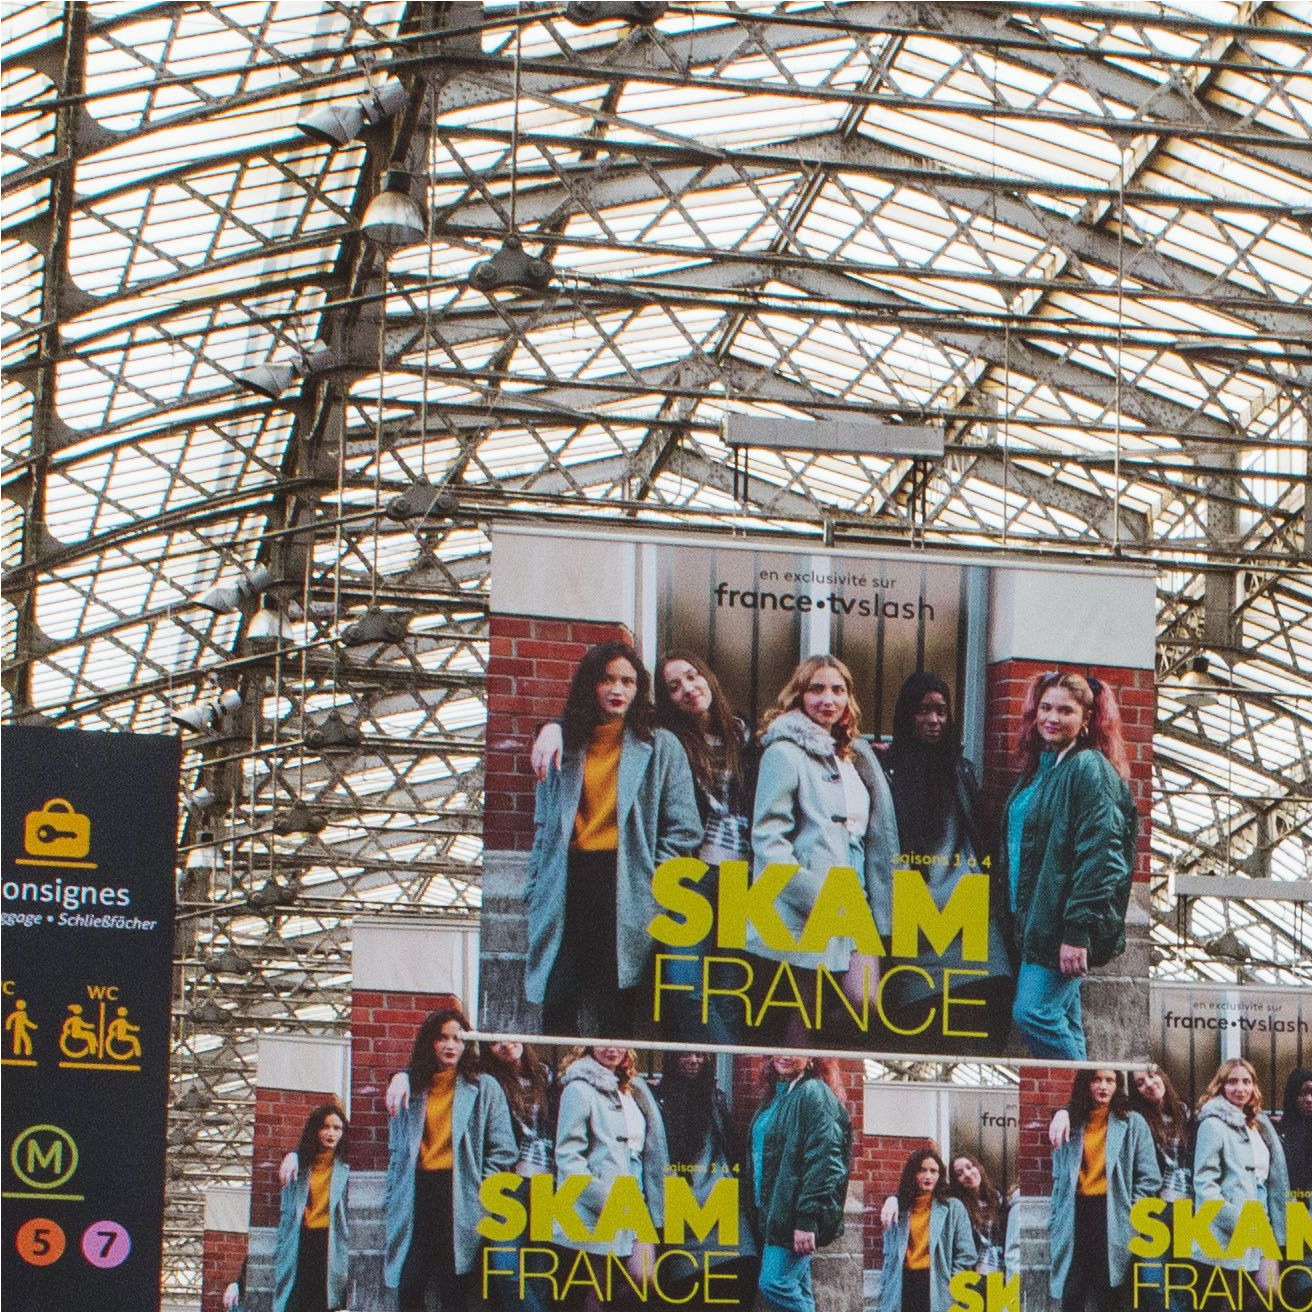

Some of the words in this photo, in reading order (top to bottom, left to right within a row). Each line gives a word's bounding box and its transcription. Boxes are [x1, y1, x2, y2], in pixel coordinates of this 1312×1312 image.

[759, 570, 778, 581] en
[784, 571, 866, 588] exclusivité
[873, 575, 895, 589] sur
[954, 853, 961, 868] 1
[982, 855, 992, 868] 4
[2, 878, 131, 911] onsignes
[646, 856, 991, 962] SKAM
[1, 980, 16, 996] C
[87, 985, 120, 1001] WC
[653, 953, 990, 1038] FRANCE
[1193, 1002, 1207, 1010] en
[1267, 1004, 1283, 1013] sur
[981, 1111, 1018, 1128] fran
[28, 1139, 63, 1174] M
[732, 1162, 740, 1174] 4
[477, 1172, 740, 1246] SKAM
[32, 1229, 51, 1256] 5
[96, 1231, 118, 1258] 7
[482, 1247, 740, 1305] FRANCE
